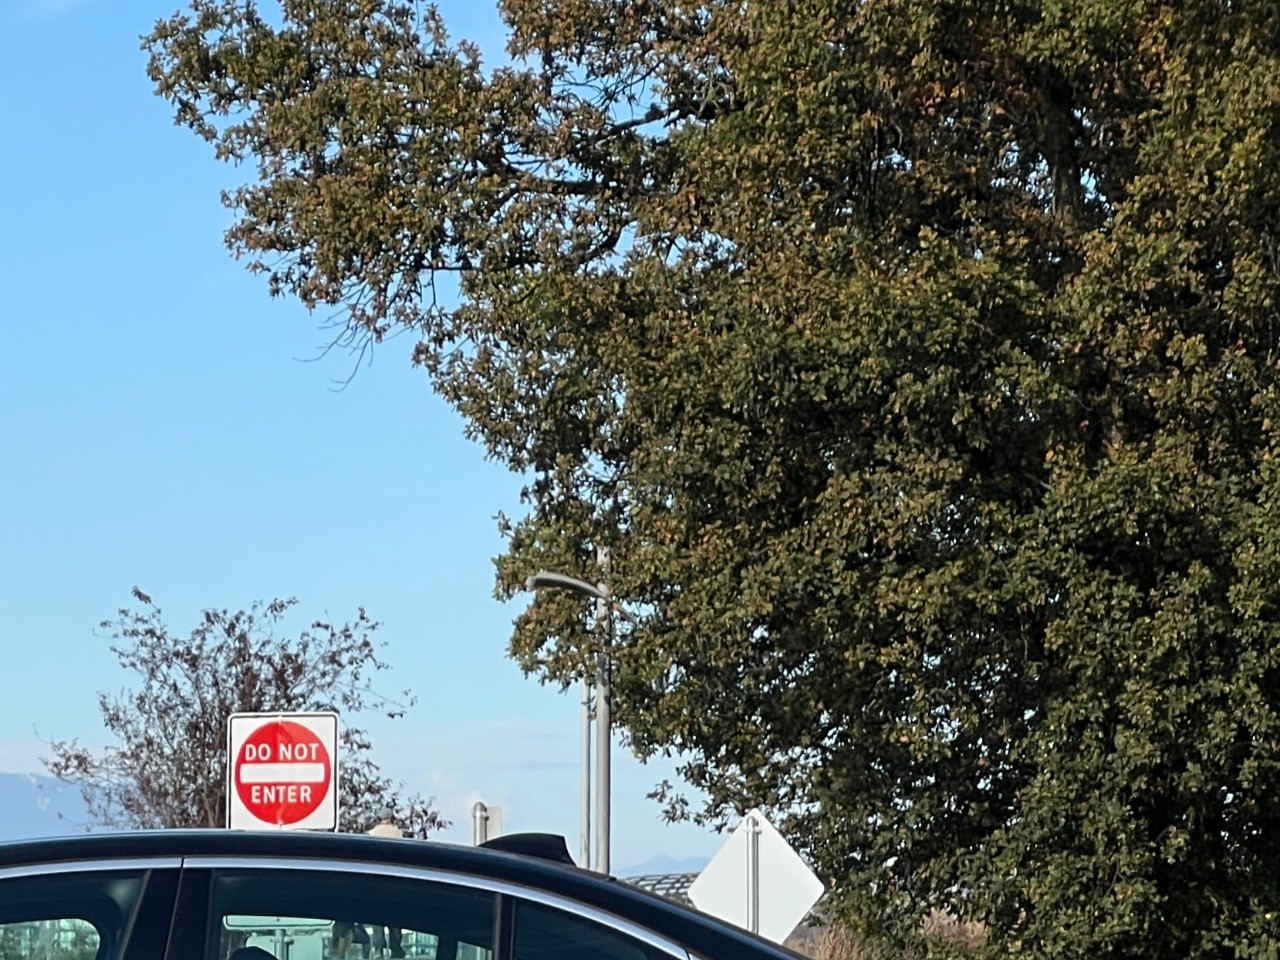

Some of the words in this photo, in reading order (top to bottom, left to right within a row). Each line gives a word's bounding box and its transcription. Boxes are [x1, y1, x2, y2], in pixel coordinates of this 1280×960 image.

[245, 743, 271, 761] DO
[279, 743, 319, 761] NOT
[251, 785, 312, 804] ENTER
